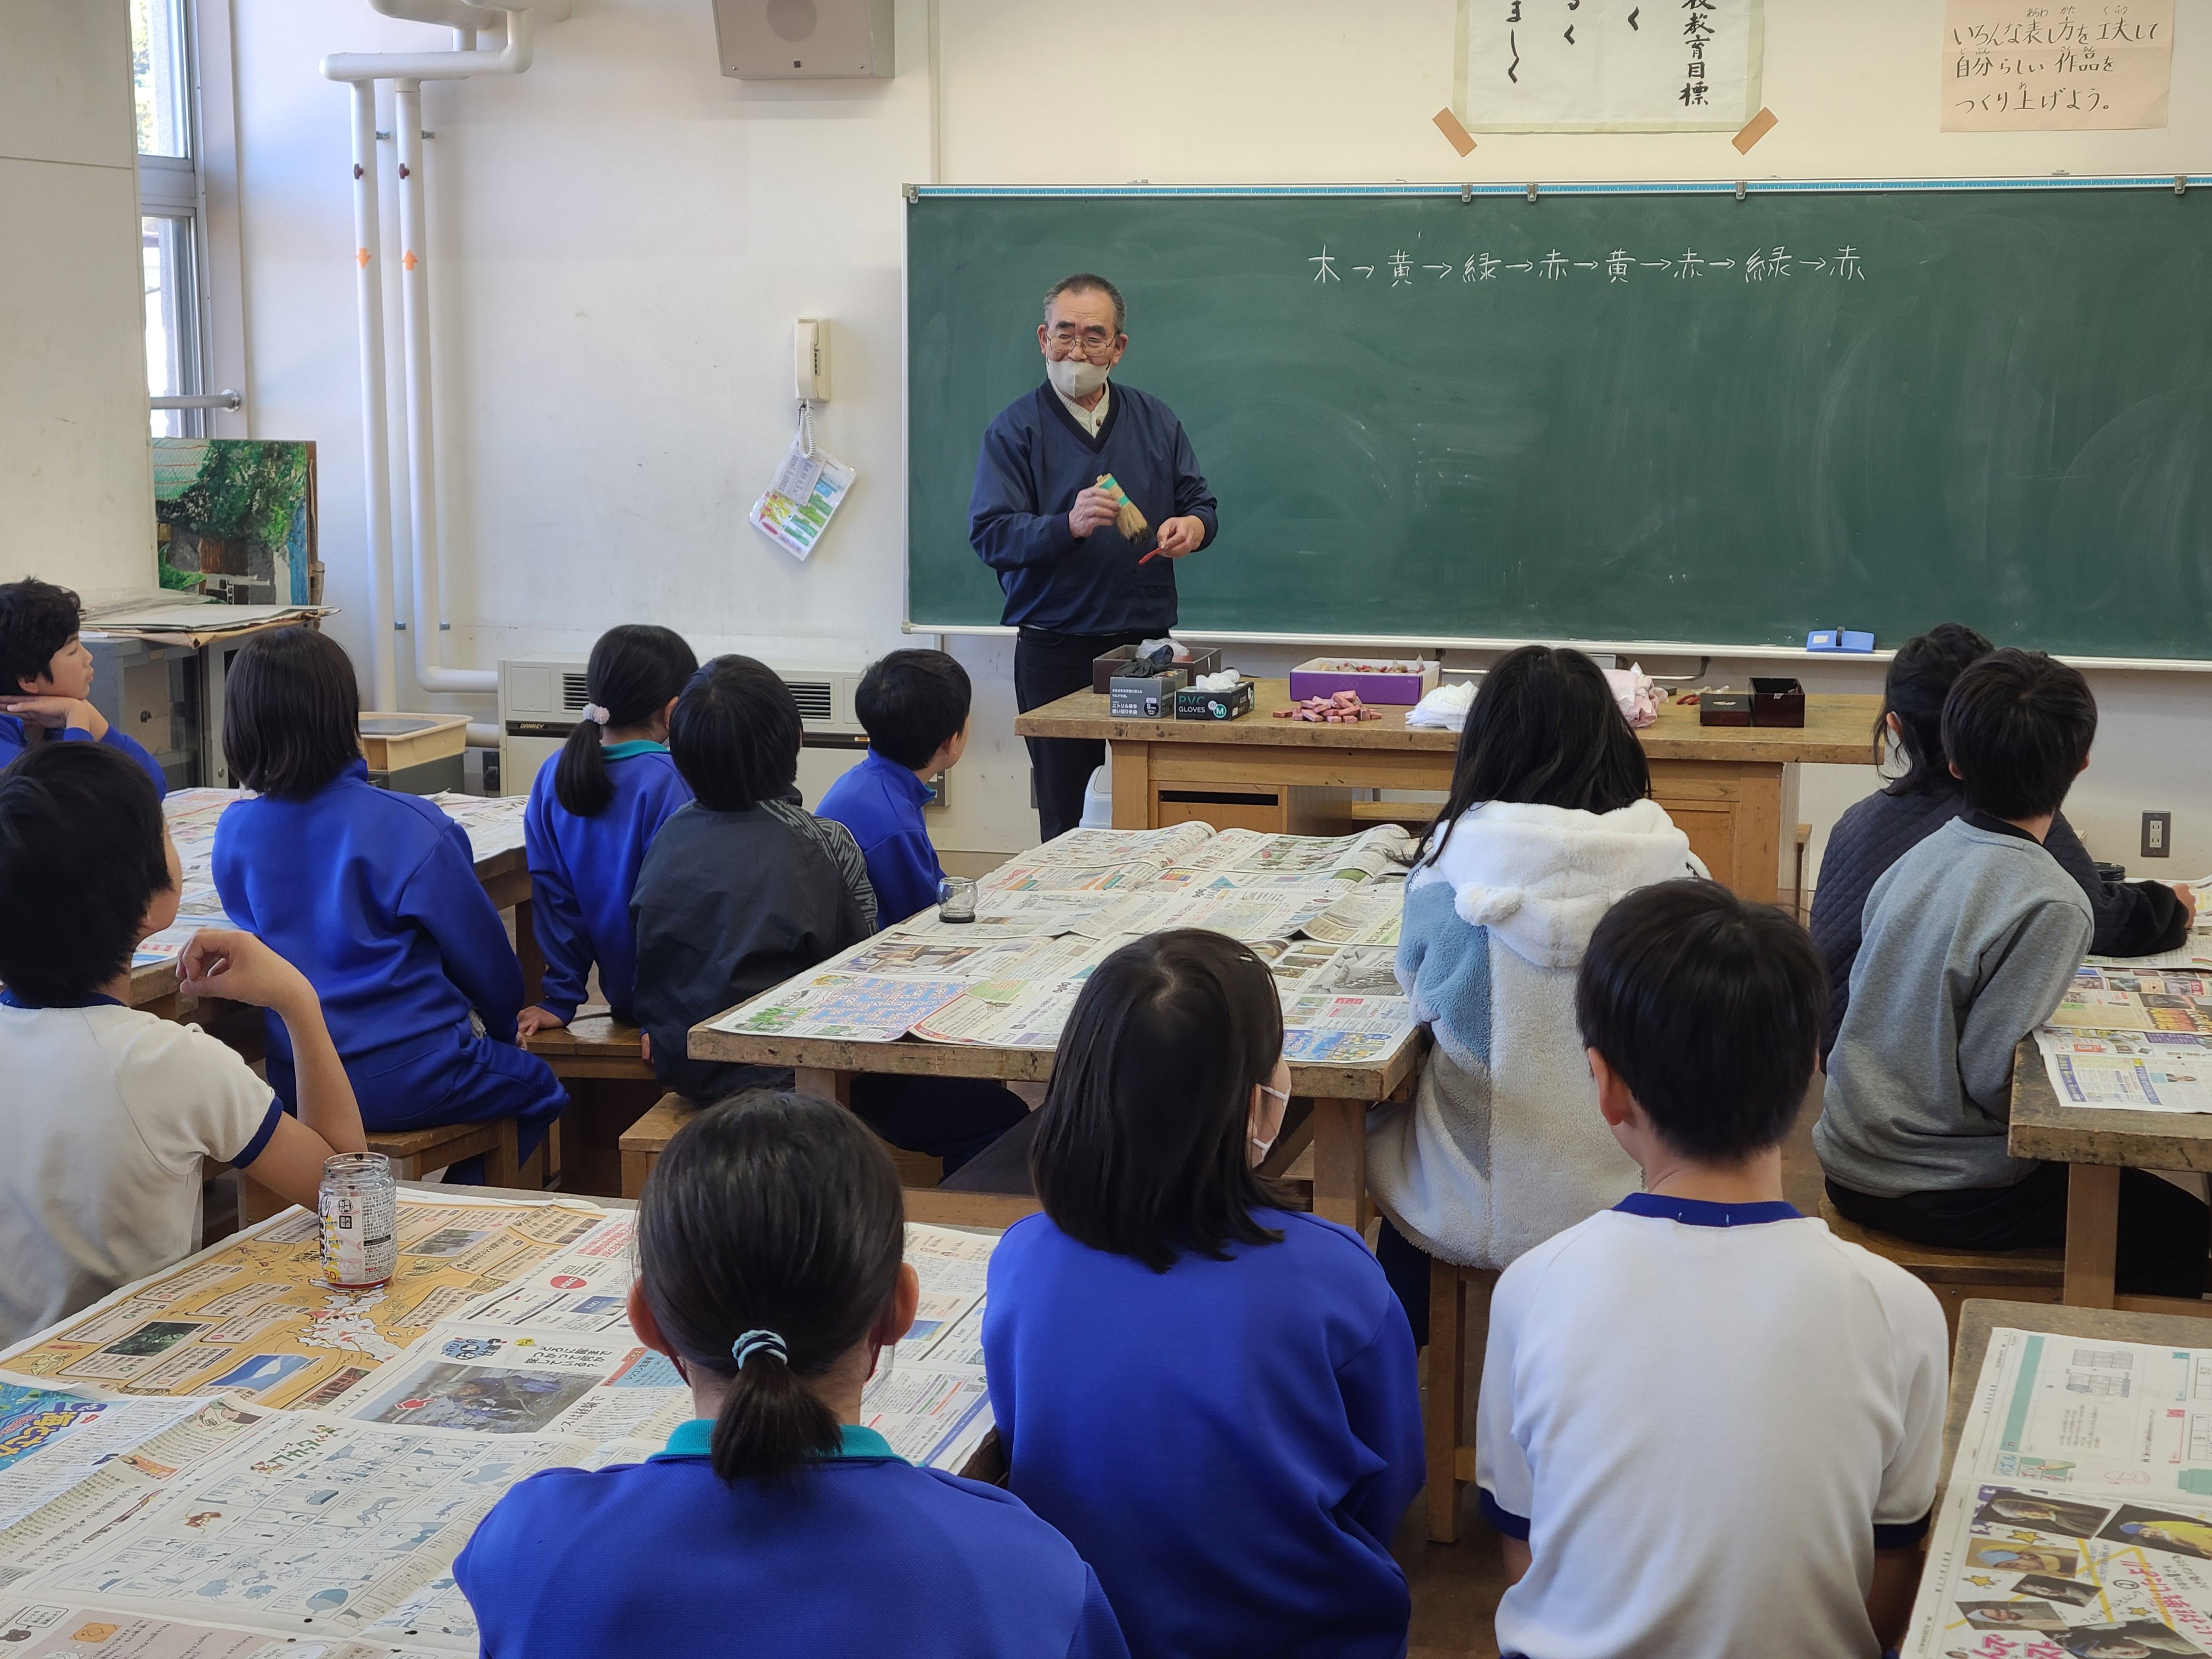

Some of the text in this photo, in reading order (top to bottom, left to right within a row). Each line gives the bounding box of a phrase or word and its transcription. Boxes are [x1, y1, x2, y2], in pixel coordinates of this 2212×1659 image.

[1309, 244, 1340, 283] 木
[1387, 249, 1414, 286] 黄
[1539, 249, 1569, 279] 赤
[1607, 249, 1637, 283] 黄
[1674, 247, 1705, 279] 赤
[1830, 245, 1865, 281] 赤
[1178, 695, 1205, 704] PVC
